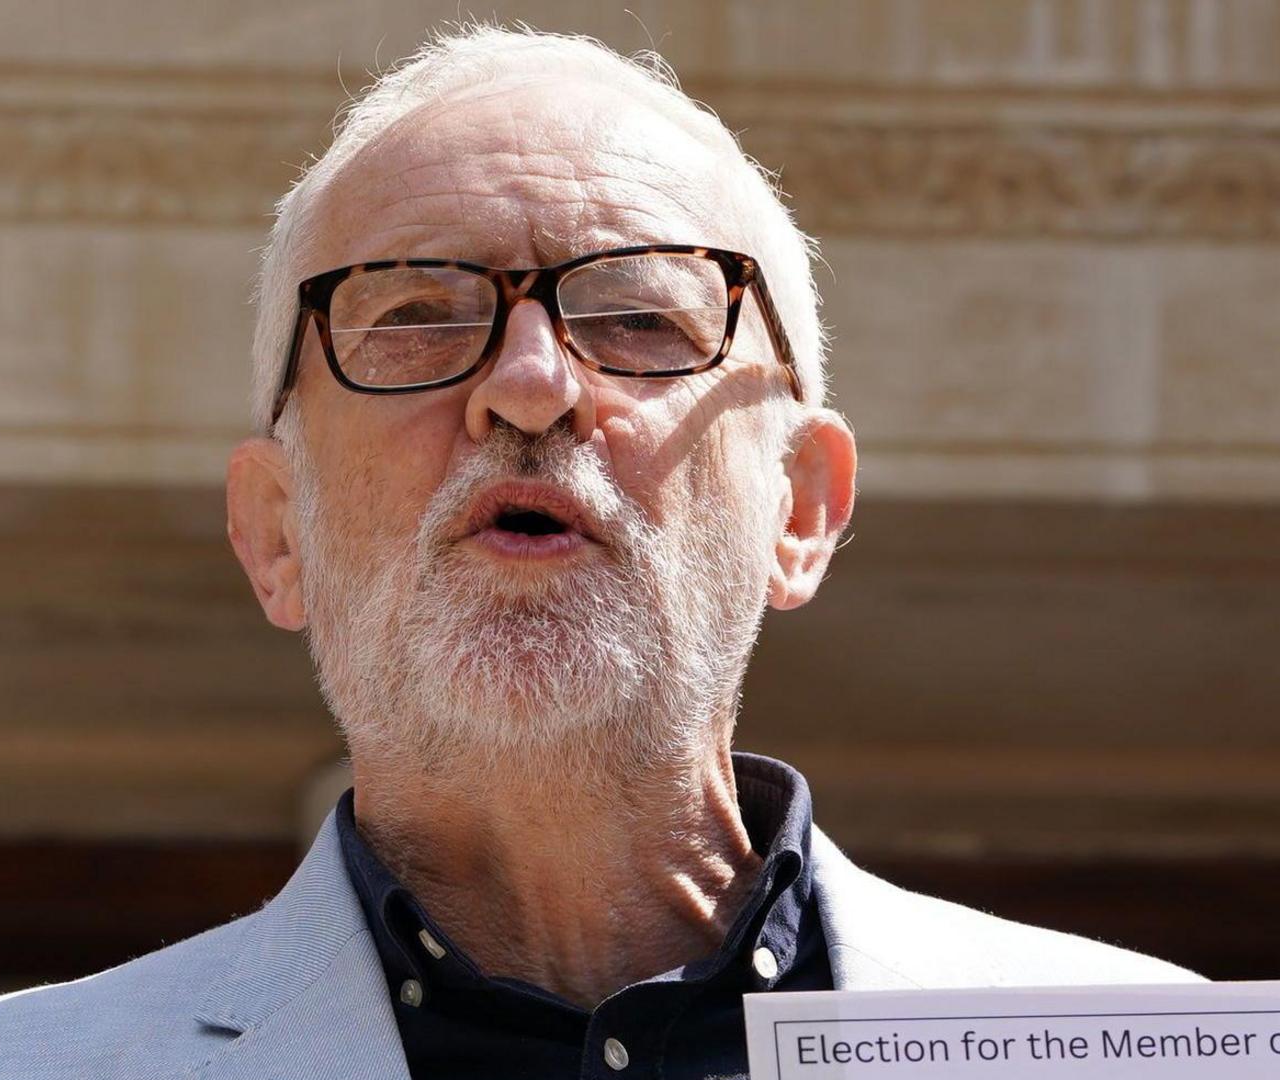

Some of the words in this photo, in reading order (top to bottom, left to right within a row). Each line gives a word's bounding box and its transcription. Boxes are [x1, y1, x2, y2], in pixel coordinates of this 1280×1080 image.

[797, 1034, 949, 1065] Election
[960, 1030, 1016, 1061] for
[1026, 1029, 1089, 1060] the
[1101, 1026, 1257, 1059] Member
